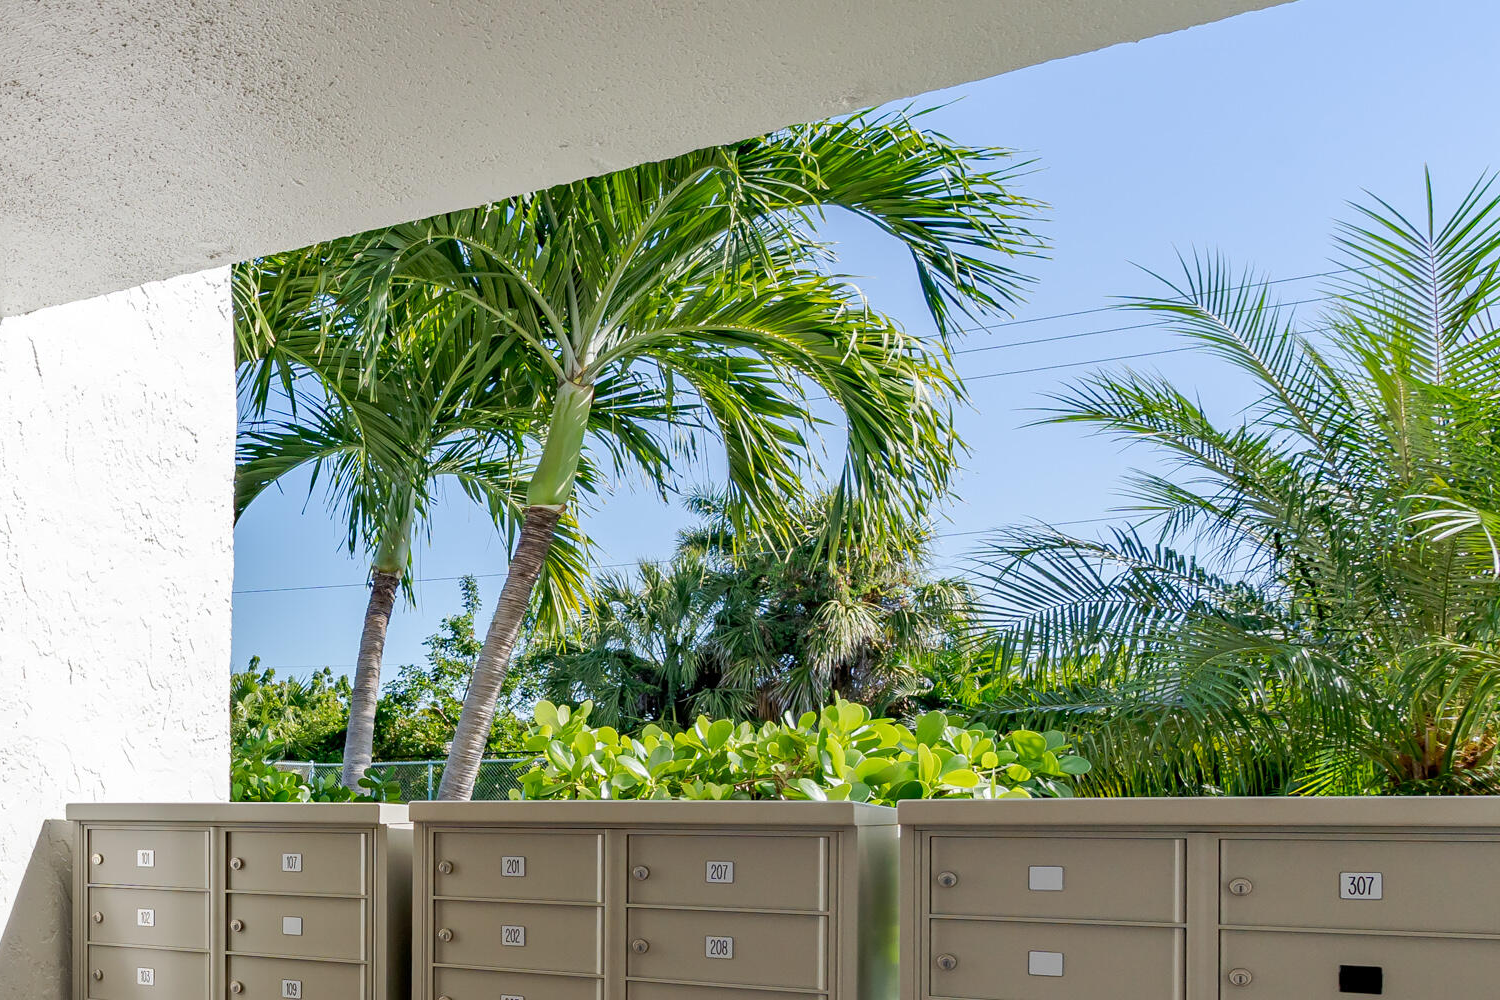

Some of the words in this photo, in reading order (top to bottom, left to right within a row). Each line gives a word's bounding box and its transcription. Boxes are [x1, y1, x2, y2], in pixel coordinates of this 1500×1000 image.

[141, 852, 150, 865] 101
[286, 856, 297, 869] 107
[507, 859, 520, 874] 201
[711, 865, 728, 880] 207
[1348, 876, 1374, 895] 307
[505, 929, 520, 944] 202
[710, 939, 728, 955] 208
[140, 970, 151, 983] 103
[285, 983, 297, 996] 109
